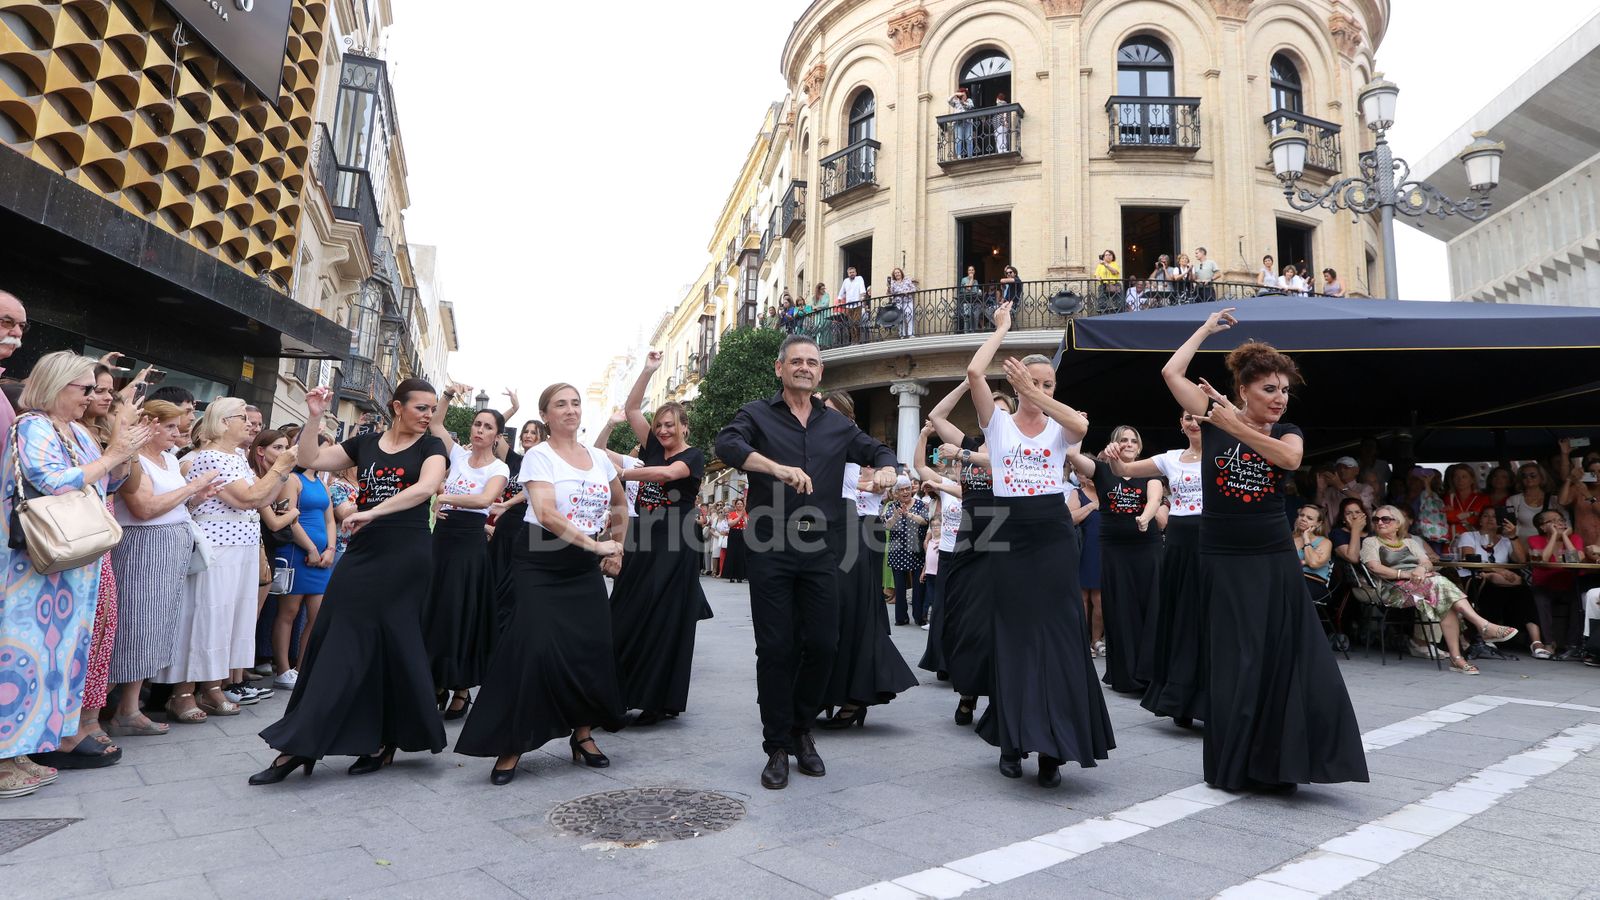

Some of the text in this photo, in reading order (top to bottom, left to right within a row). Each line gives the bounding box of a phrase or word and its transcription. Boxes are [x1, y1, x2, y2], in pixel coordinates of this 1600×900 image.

[206, 0, 229, 22] GIA
[1002, 443, 1047, 468] Acento
[1214, 443, 1272, 471] Acento
[359, 461, 402, 491] Acento
[1230, 462, 1262, 478] tesoro
[1227, 480, 1262, 492] nunca
